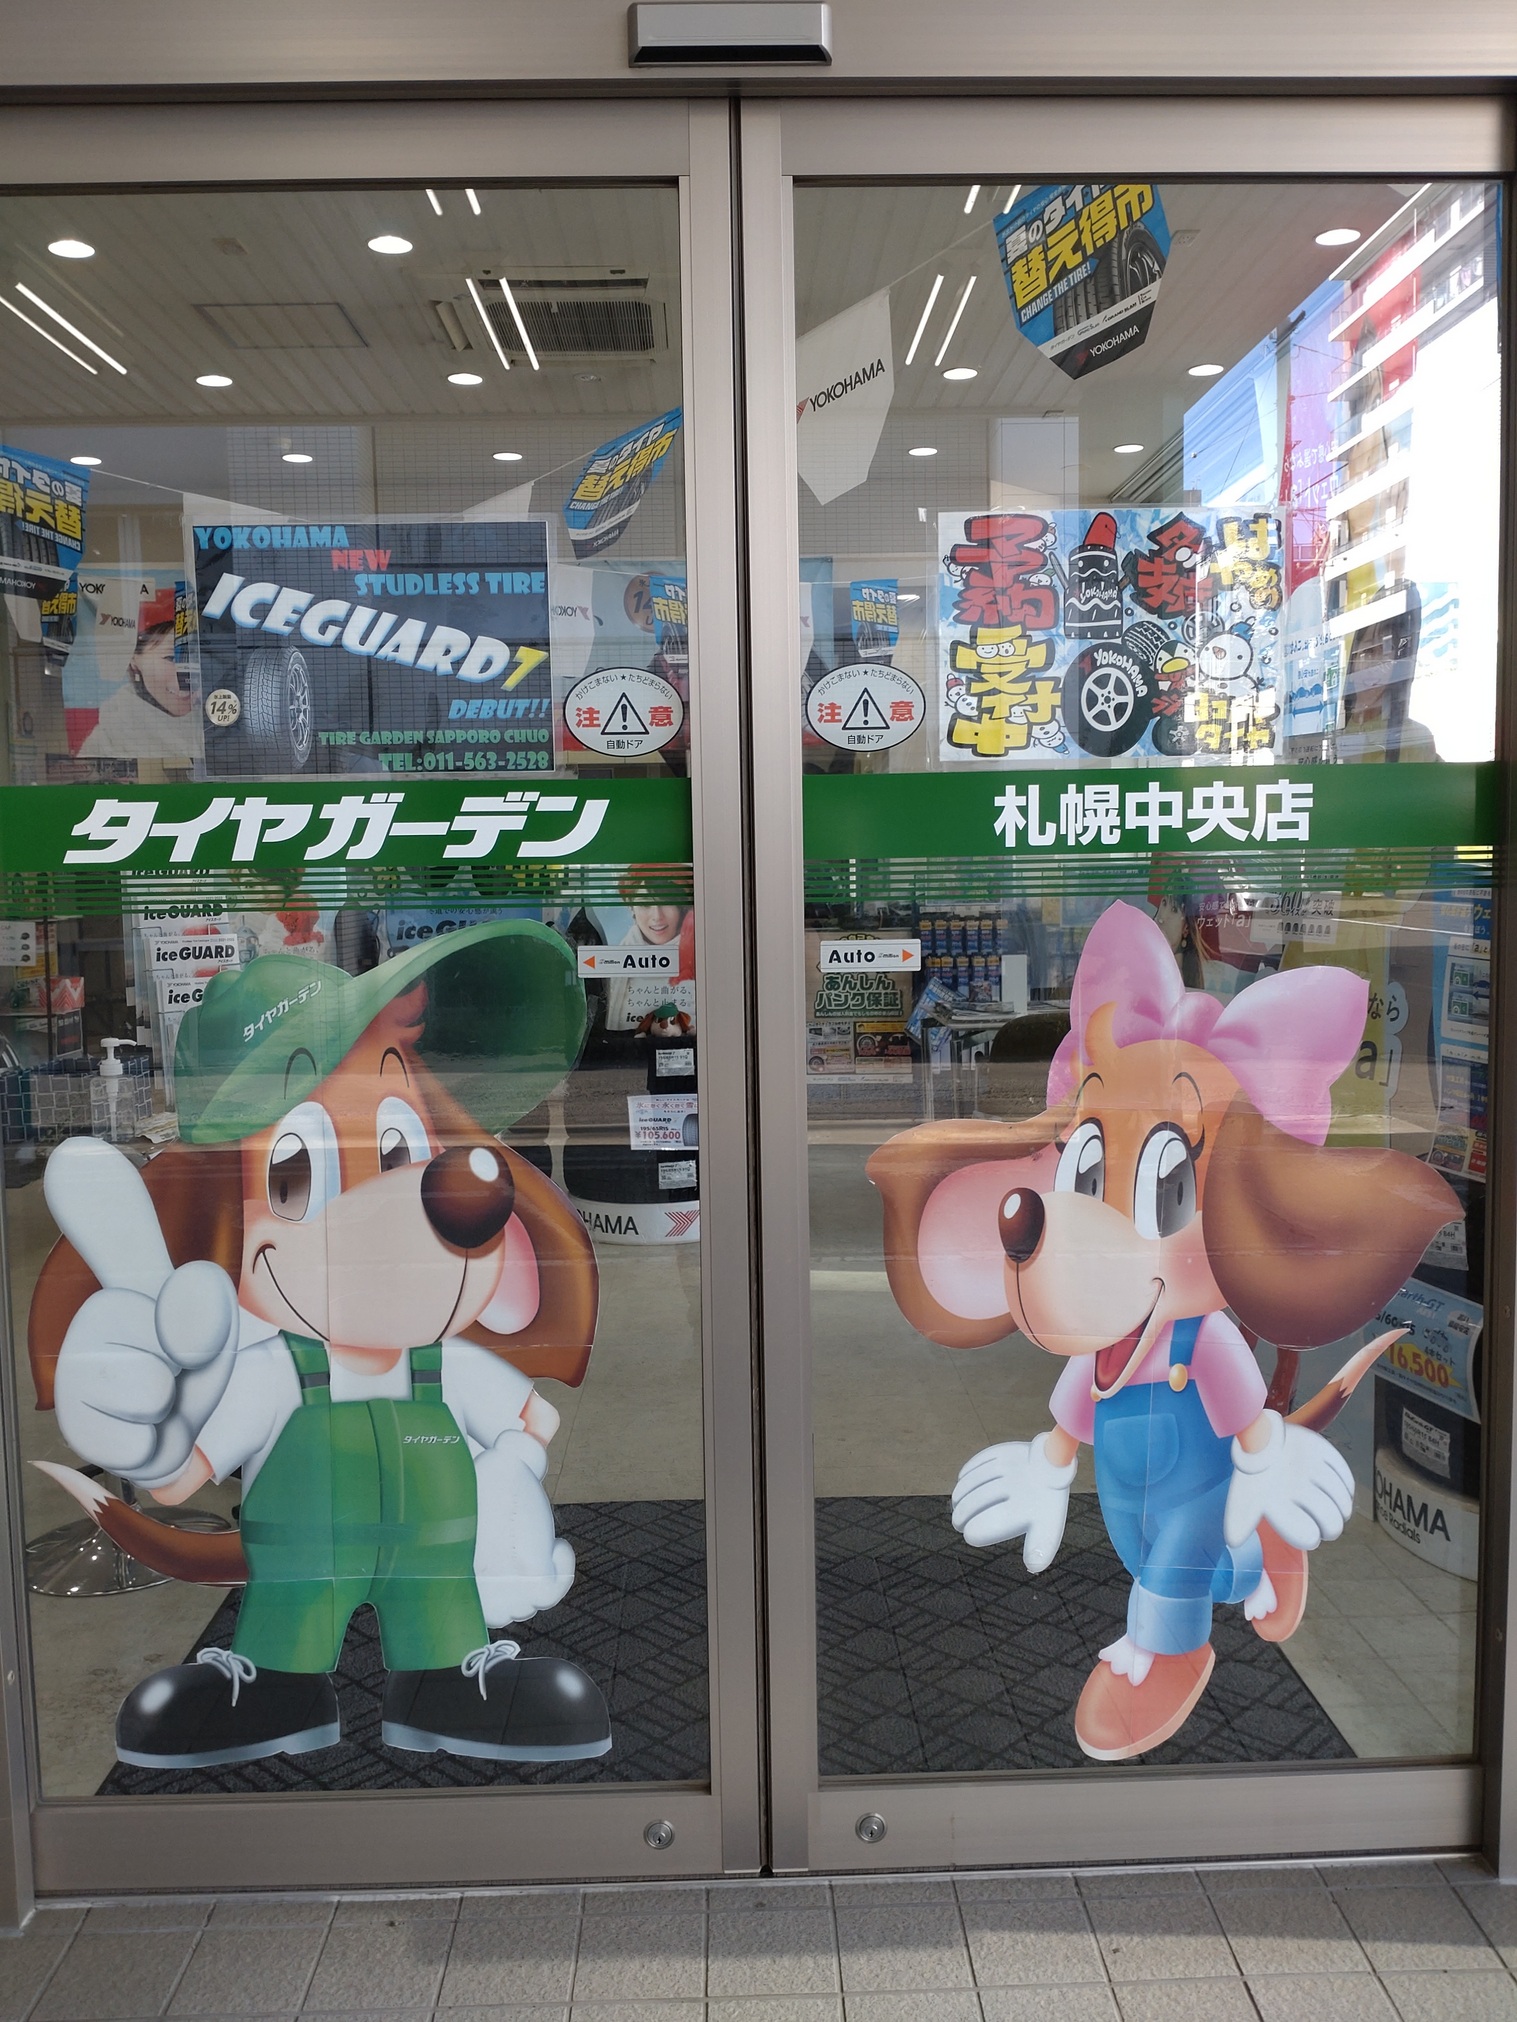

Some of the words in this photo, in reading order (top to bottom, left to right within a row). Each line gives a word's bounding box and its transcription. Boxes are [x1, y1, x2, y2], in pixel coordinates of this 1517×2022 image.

[1005, 185, 1106, 265] 夏のタイ
[1020, 286, 1053, 323] CHANGE
[1053, 277, 1069, 300] THE
[1068, 261, 1091, 290] TIRE!
[1089, 324, 1139, 357] YOKOHAMA
[810, 359, 885, 412] YOKOHAMA
[572, 428, 678, 500] 替え得市
[194, 525, 349, 551] YOKOHAMA
[331, 549, 391, 571] NEW
[80, 583, 149, 595] YOKA
[354, 572, 480, 597] STUDLESS
[485, 571, 545, 595] TIRE
[817, 668, 861, 697] かけこまない
[870, 668, 915, 696] たちどまらない
[1093, 648, 1148, 698] YOKOHAMA
[575, 673, 618, 701] かけこまない
[628, 672, 674, 700] たちどまらない
[217, 714, 230, 722] UP!
[448, 698, 551, 720] DEBUT!!
[318, 731, 356, 746] TIRE
[359, 731, 423, 746] GARDEN
[427, 730, 501, 745] SAPPORO
[503, 729, 550, 744] CHUO
[606, 738, 644, 751] 自動ドア
[847, 733, 884, 746] 自動ドア
[378, 752, 549, 772] TEL:011-563-2528
[993, 780, 1314, 848] 札幌中央店
[63, 792, 610, 864] タイヤガーデン
[144, 903, 223, 920] iceGUARD
[156, 945, 235, 962] iceGUARD
[623, 954, 671, 969] Auto
[828, 949, 876, 963] Auto
[824, 974, 896, 992] あんしん
[243, 980, 322, 1042] タイヤガーデン
[814, 990, 903, 1010] パンク保証
[577, 1209, 640, 1236] HAMA
[403, 1435, 460, 1444] タイヤガーデン
[1389, 1513, 1422, 1545] Radials
